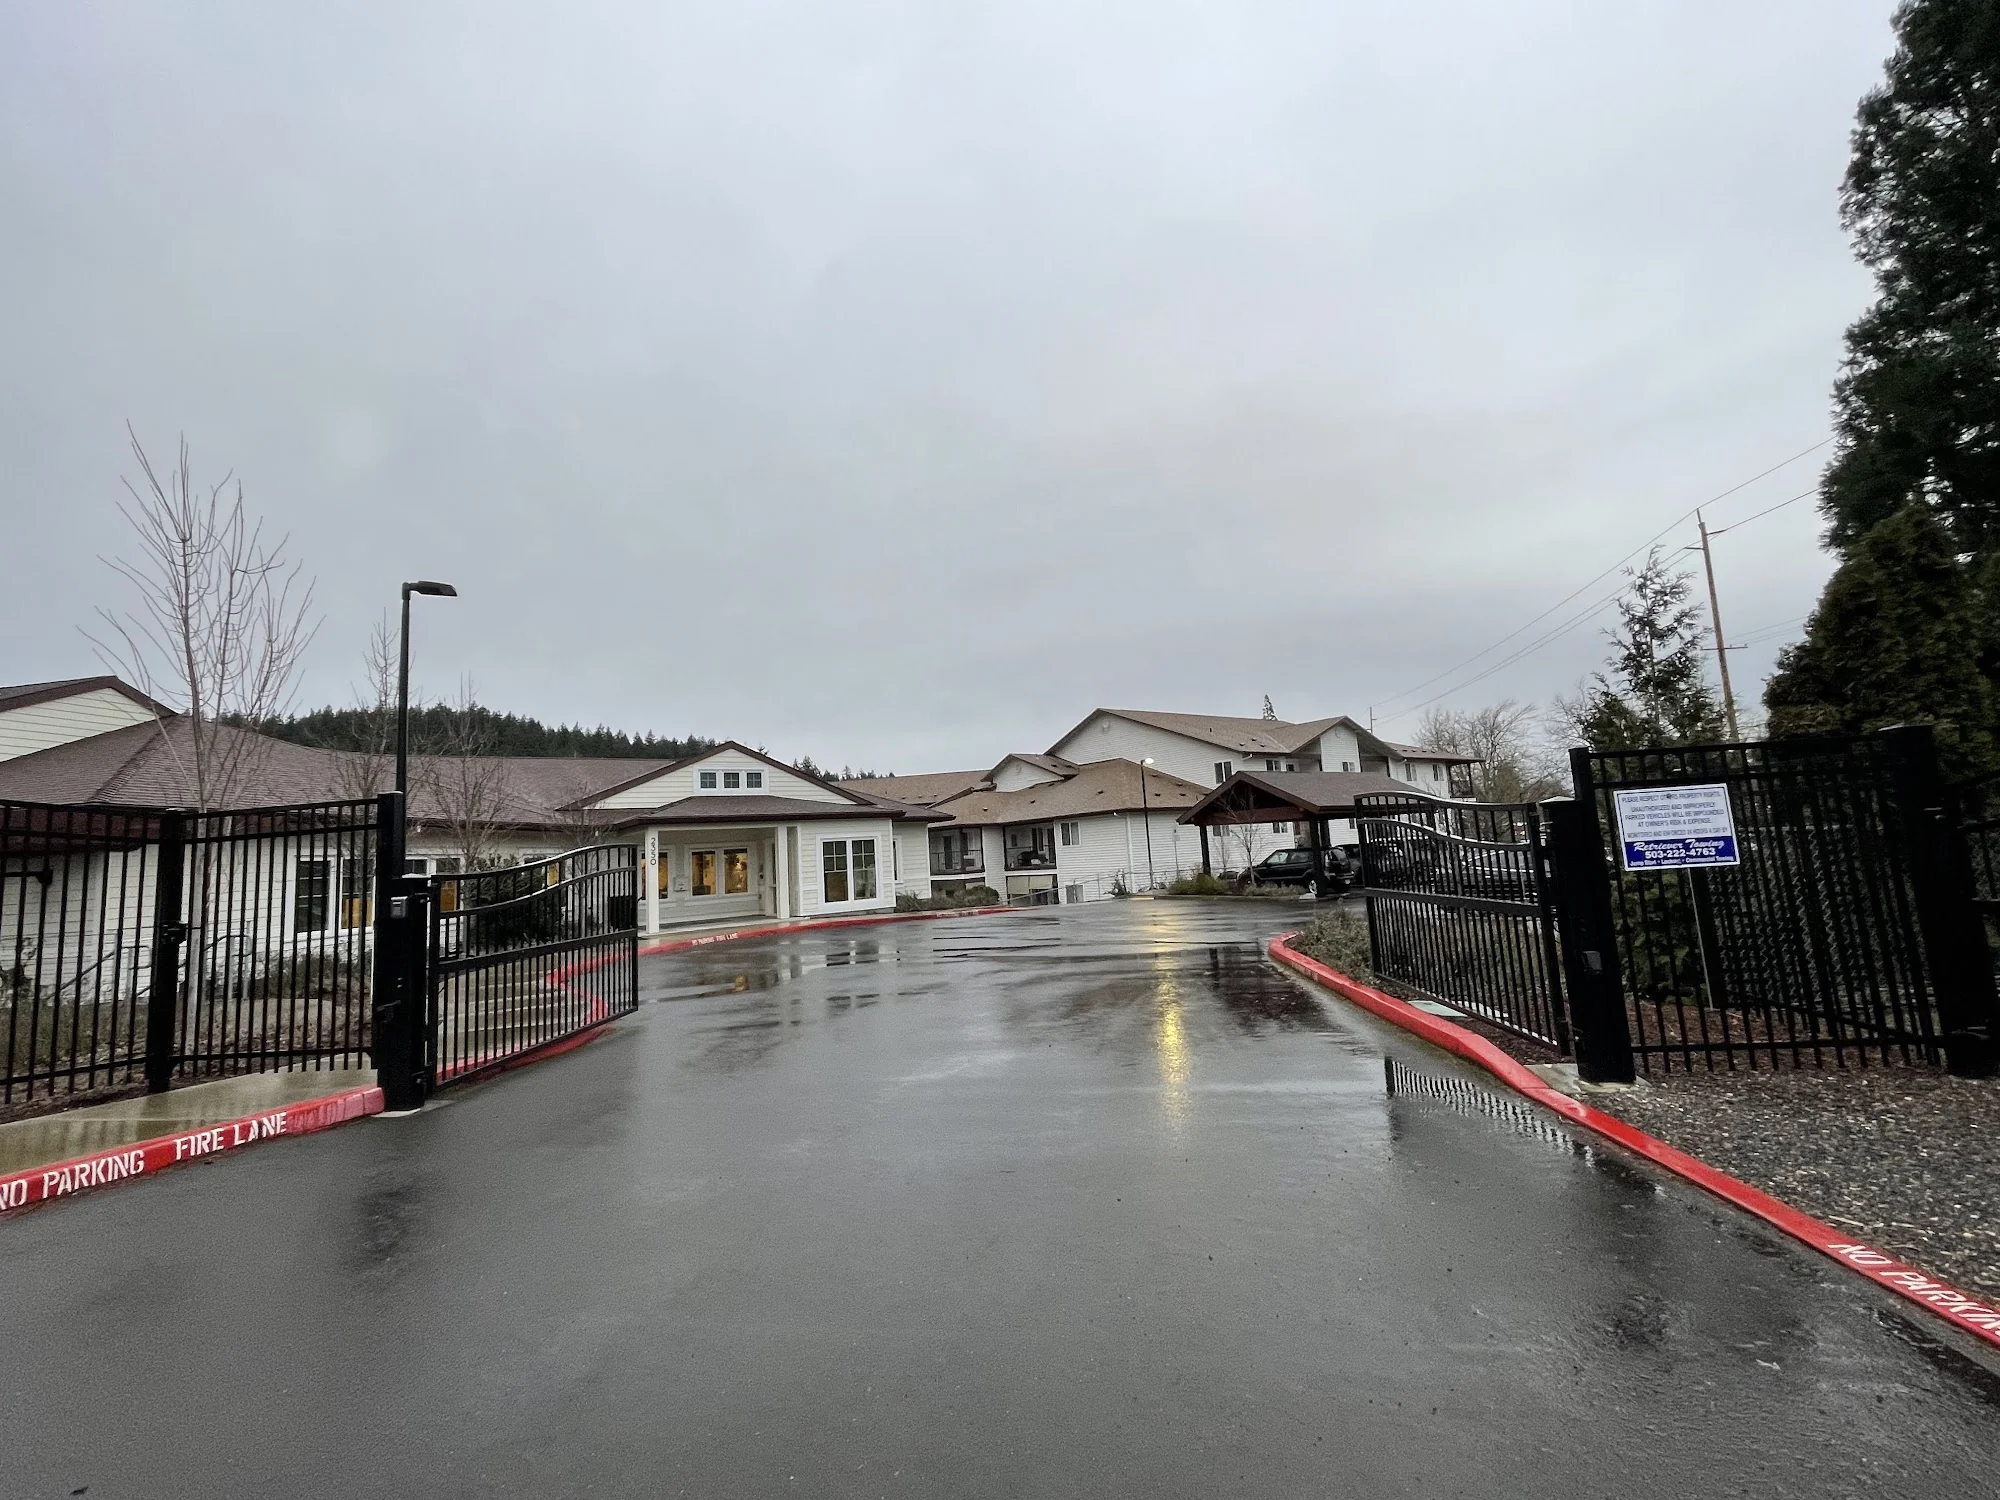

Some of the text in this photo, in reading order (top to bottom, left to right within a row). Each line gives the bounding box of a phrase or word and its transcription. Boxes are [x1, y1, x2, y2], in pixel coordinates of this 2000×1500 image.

[1646, 812, 1671, 820] VEHICLES
[1633, 839, 1725, 852] Retriever Towing
[1645, 847, 1716, 859] 503-222-4763
[42, 1149, 145, 1199] PARKING
[173, 1127, 225, 1161] FIRE
[233, 1111, 288, 1147] LANE
[1827, 1244, 2000, 1337] NO PARKIN
